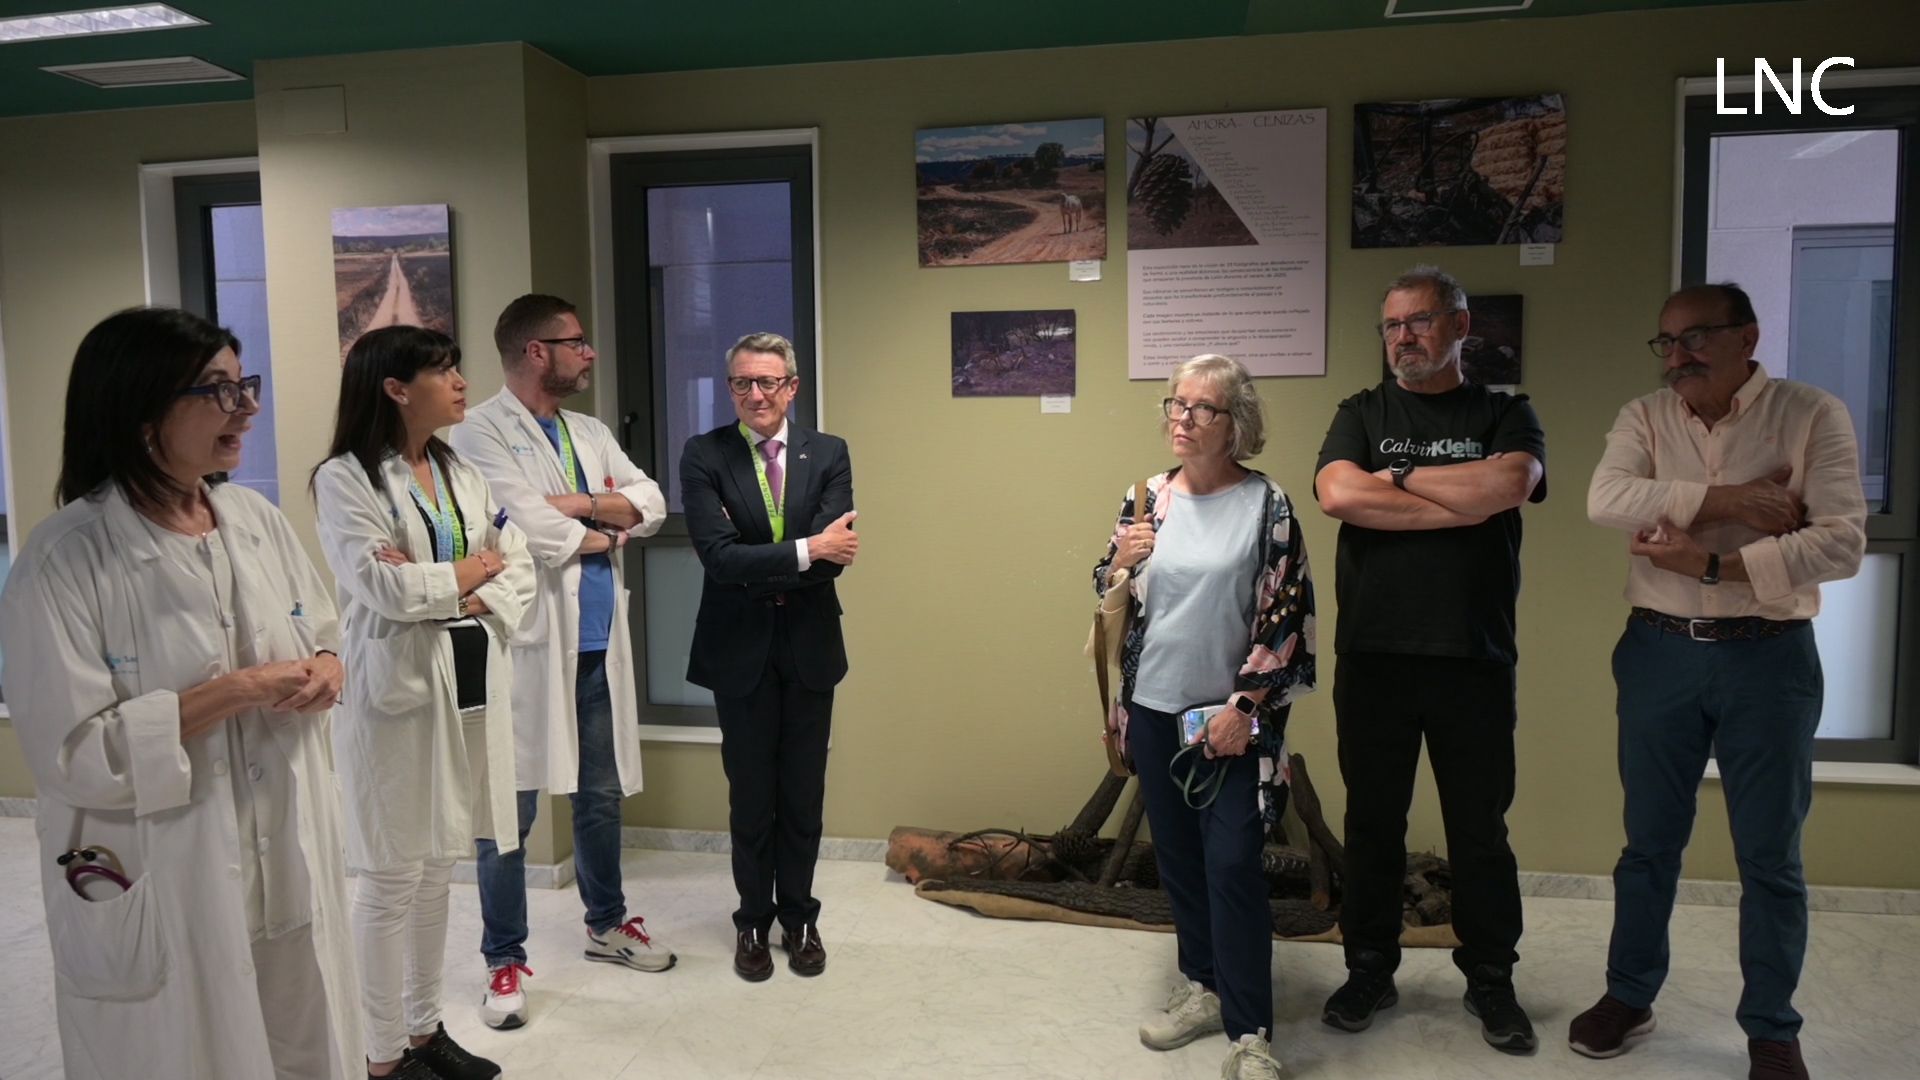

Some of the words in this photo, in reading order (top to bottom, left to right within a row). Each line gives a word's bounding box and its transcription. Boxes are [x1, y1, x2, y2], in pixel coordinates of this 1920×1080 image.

[1252, 112, 1315, 128] CENIZAS
[1380, 438, 1434, 457] Calvin
[1431, 437, 1483, 457] Klein
